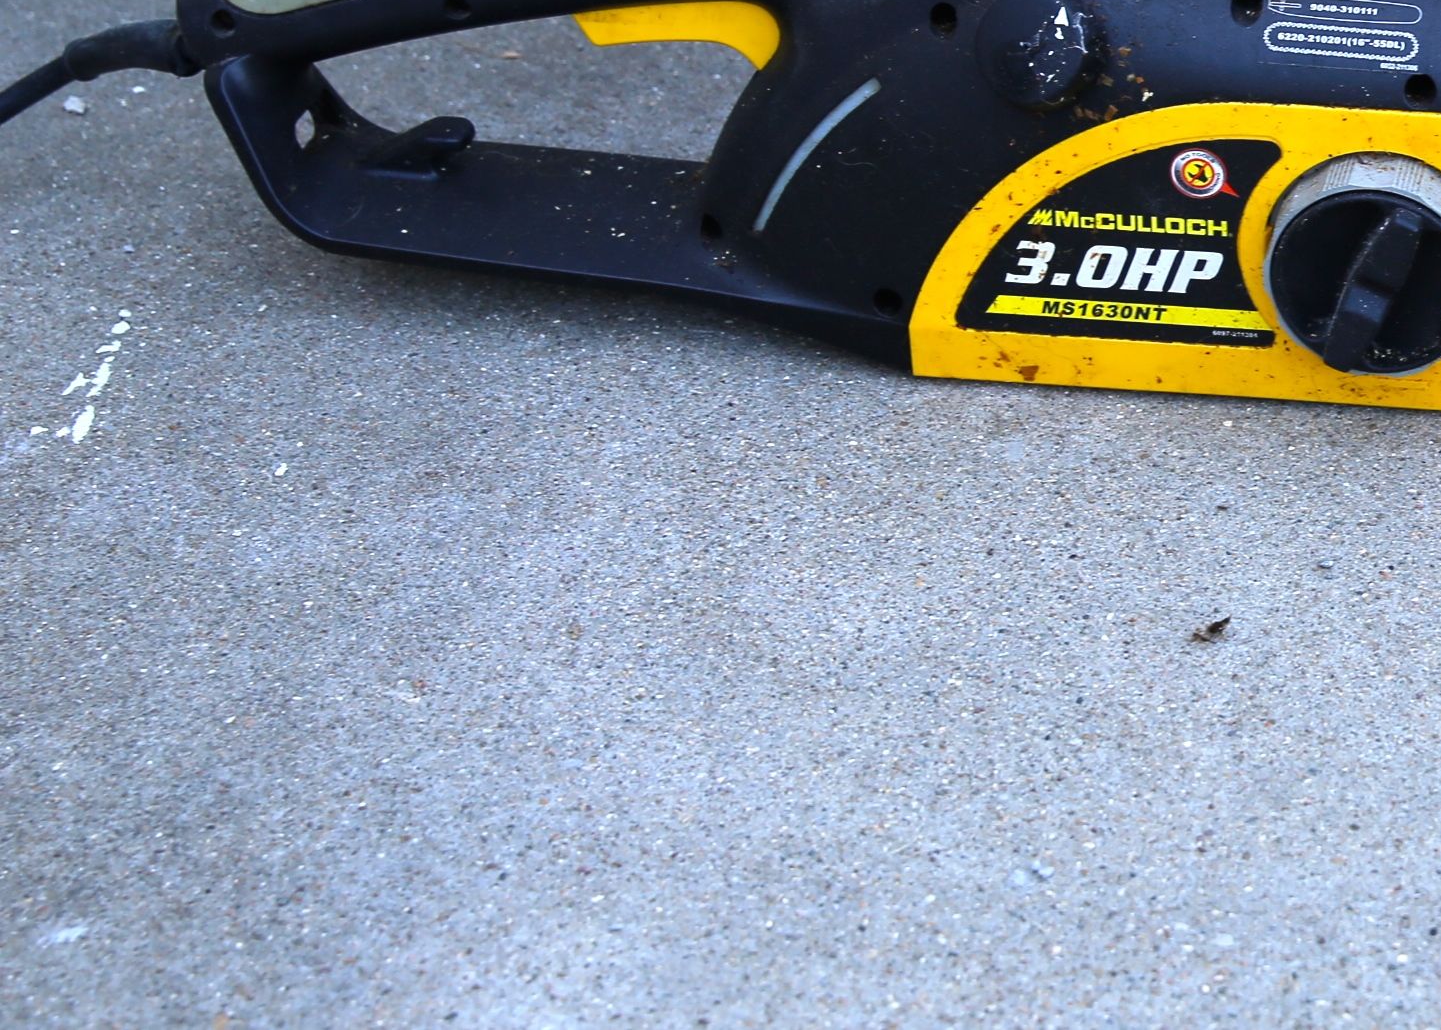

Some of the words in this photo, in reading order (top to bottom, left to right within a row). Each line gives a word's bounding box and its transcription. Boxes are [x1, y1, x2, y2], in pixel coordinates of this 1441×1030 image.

[1309, 3, 1379, 16] 9040-310111
[1054, 210, 1229, 237] McCULLOCH
[1004, 240, 1224, 294] 3.0HP
[1041, 300, 1168, 321] MS1630NT
